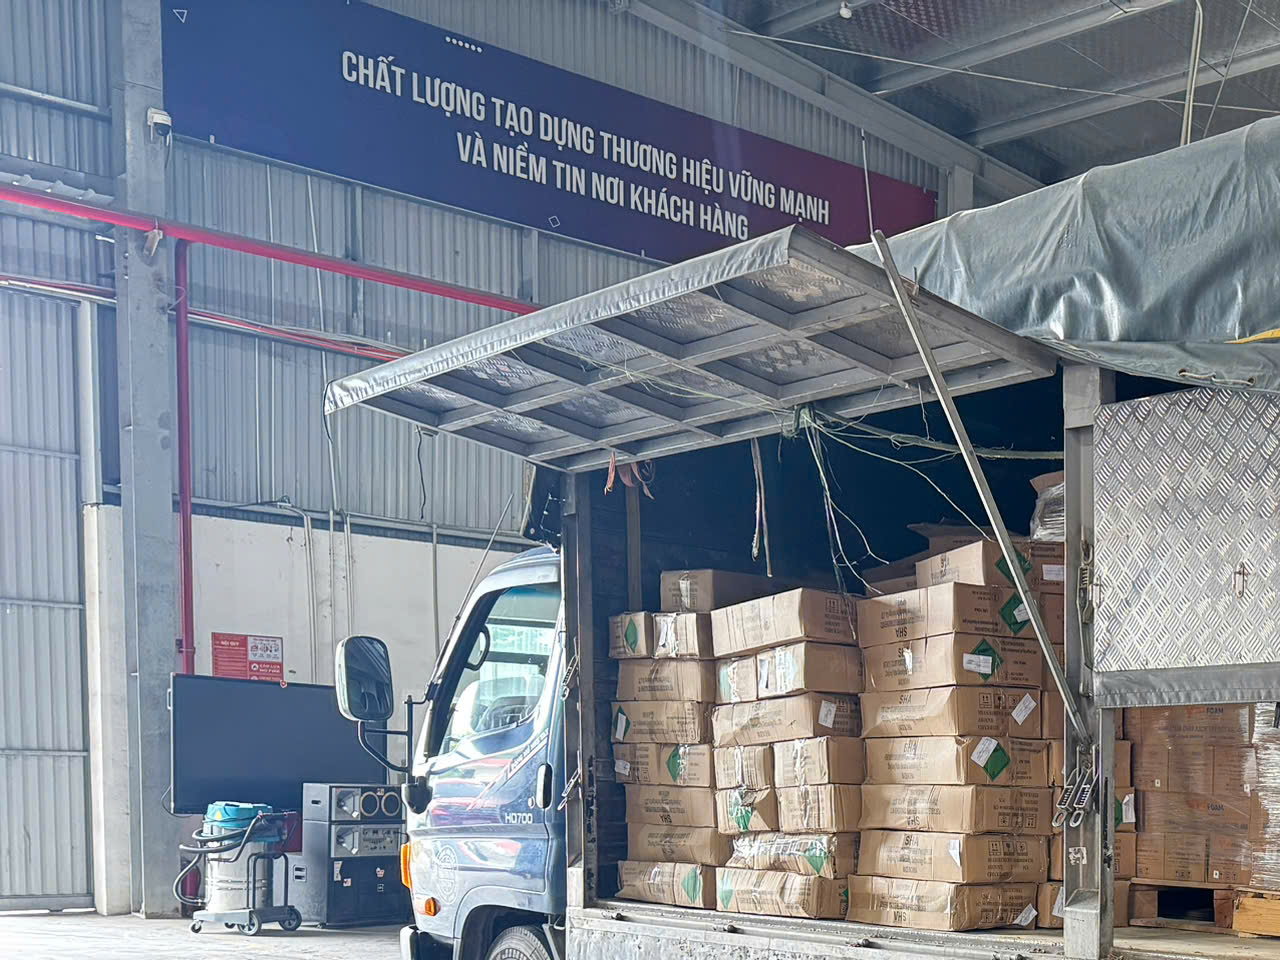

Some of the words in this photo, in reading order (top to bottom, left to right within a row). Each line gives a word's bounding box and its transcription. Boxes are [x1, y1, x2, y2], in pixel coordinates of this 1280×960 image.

[342, 51, 405, 97] CHẤT
[412, 72, 486, 121] LƯỢNG
[491, 96, 534, 137] TẠO
[539, 112, 595, 154] DỰNG
[599, 130, 677, 180] THƯƠNG
[682, 156, 724, 195] HIỆU
[728, 169, 776, 209] VỮNG
[780, 187, 830, 225] MẠNH
[456, 131, 487, 169] VÀ
[493, 143, 547, 185] NIỀM
[552, 160, 586, 196] TIN
[591, 171, 625, 207] NƠI
[630, 184, 694, 227] KHÁCH
[700, 203, 749, 241] HÀNG
